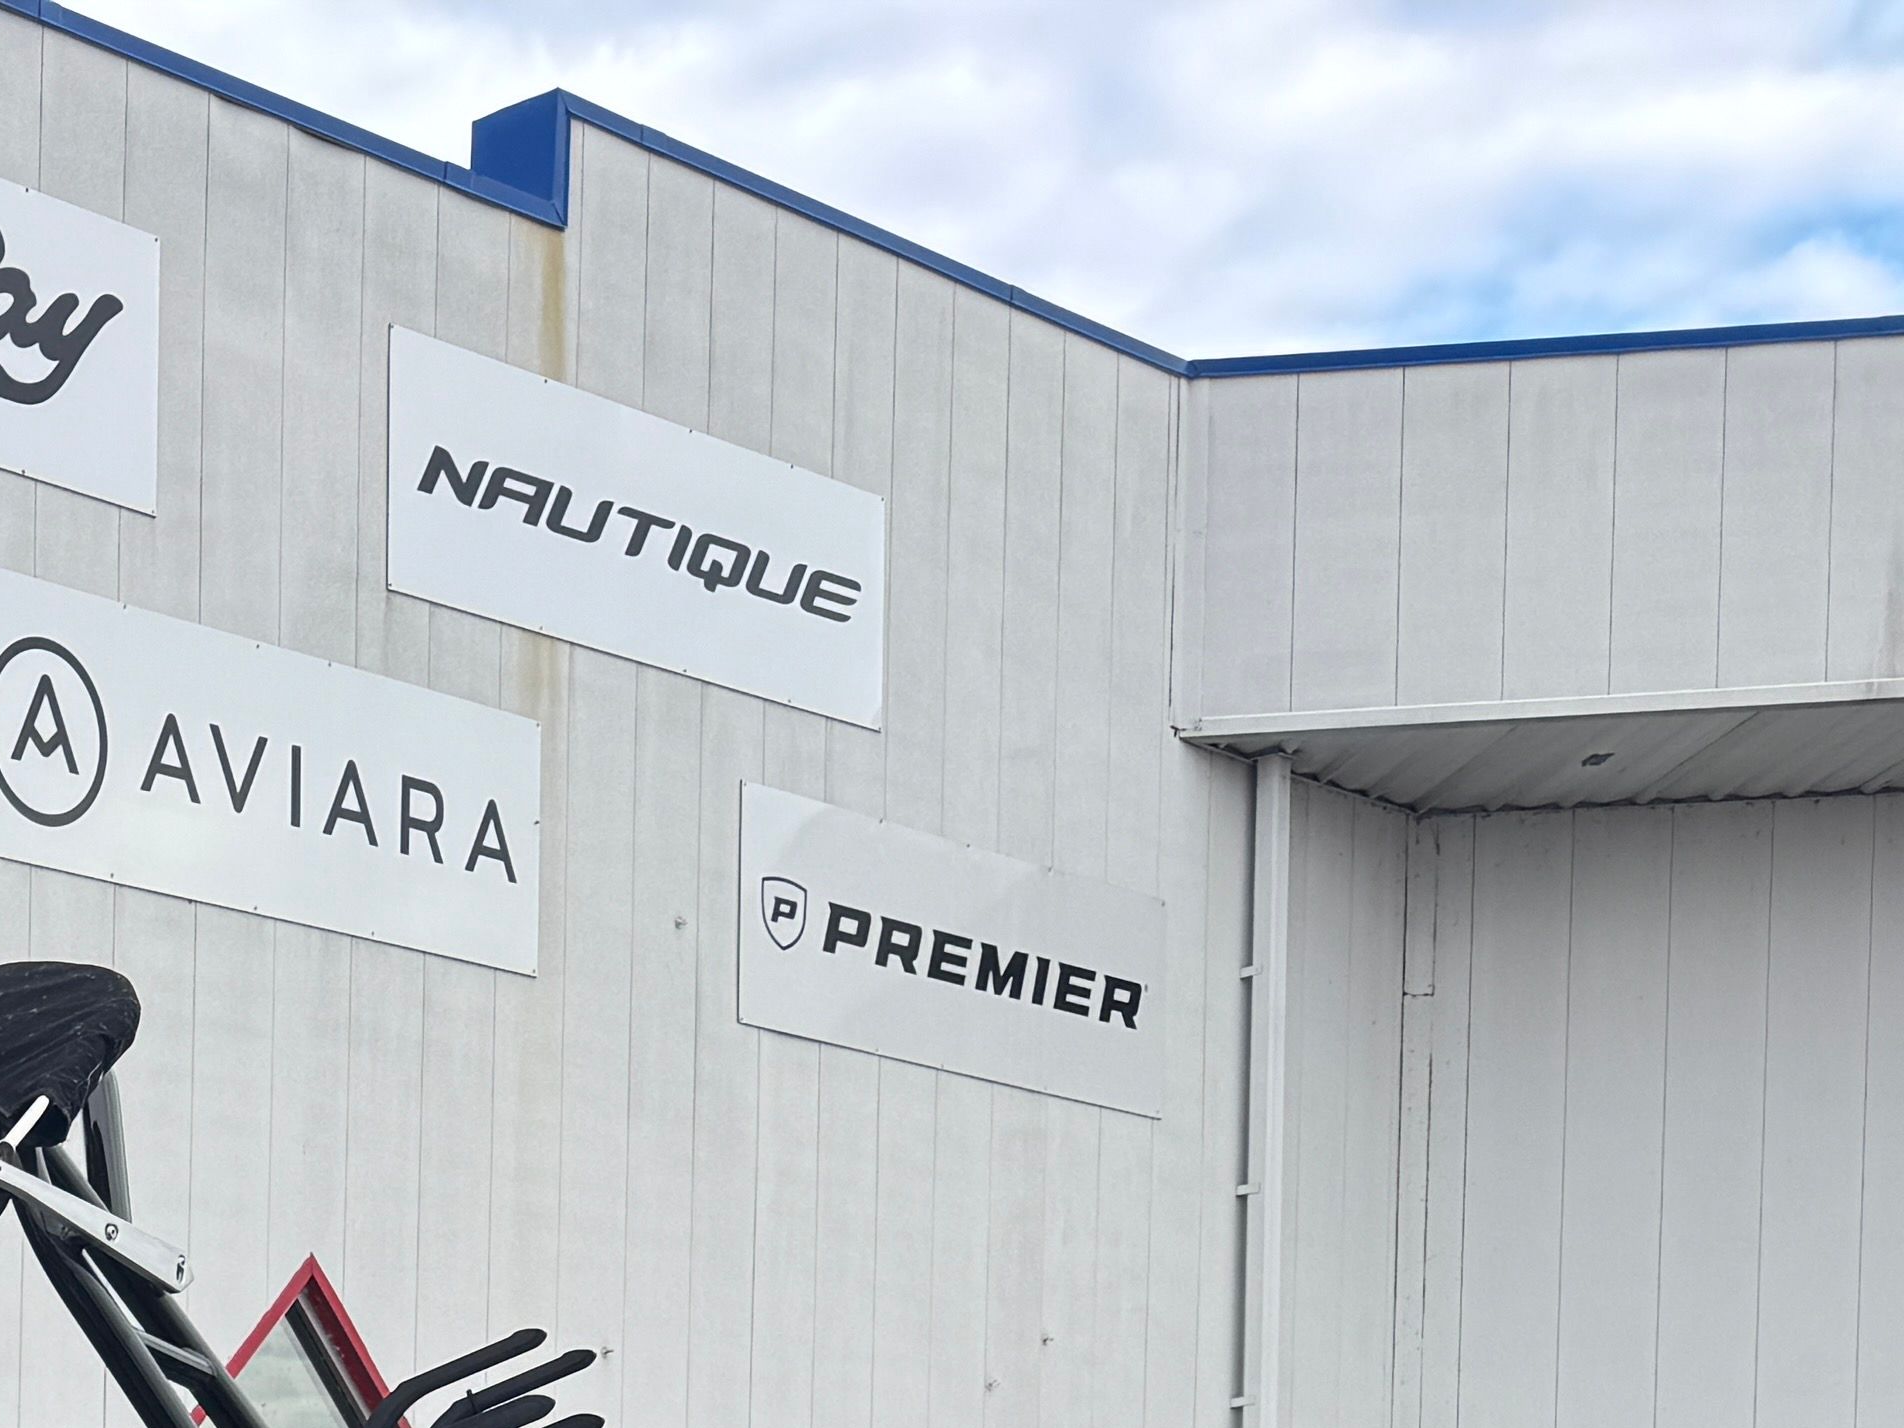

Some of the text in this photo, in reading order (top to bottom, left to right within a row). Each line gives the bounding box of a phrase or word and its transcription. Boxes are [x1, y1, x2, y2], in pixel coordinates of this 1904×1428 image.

[417, 445, 862, 623] NAUTIQUE
[140, 713, 517, 884] AVIARA
[770, 896, 1144, 1030] P PREMIER
